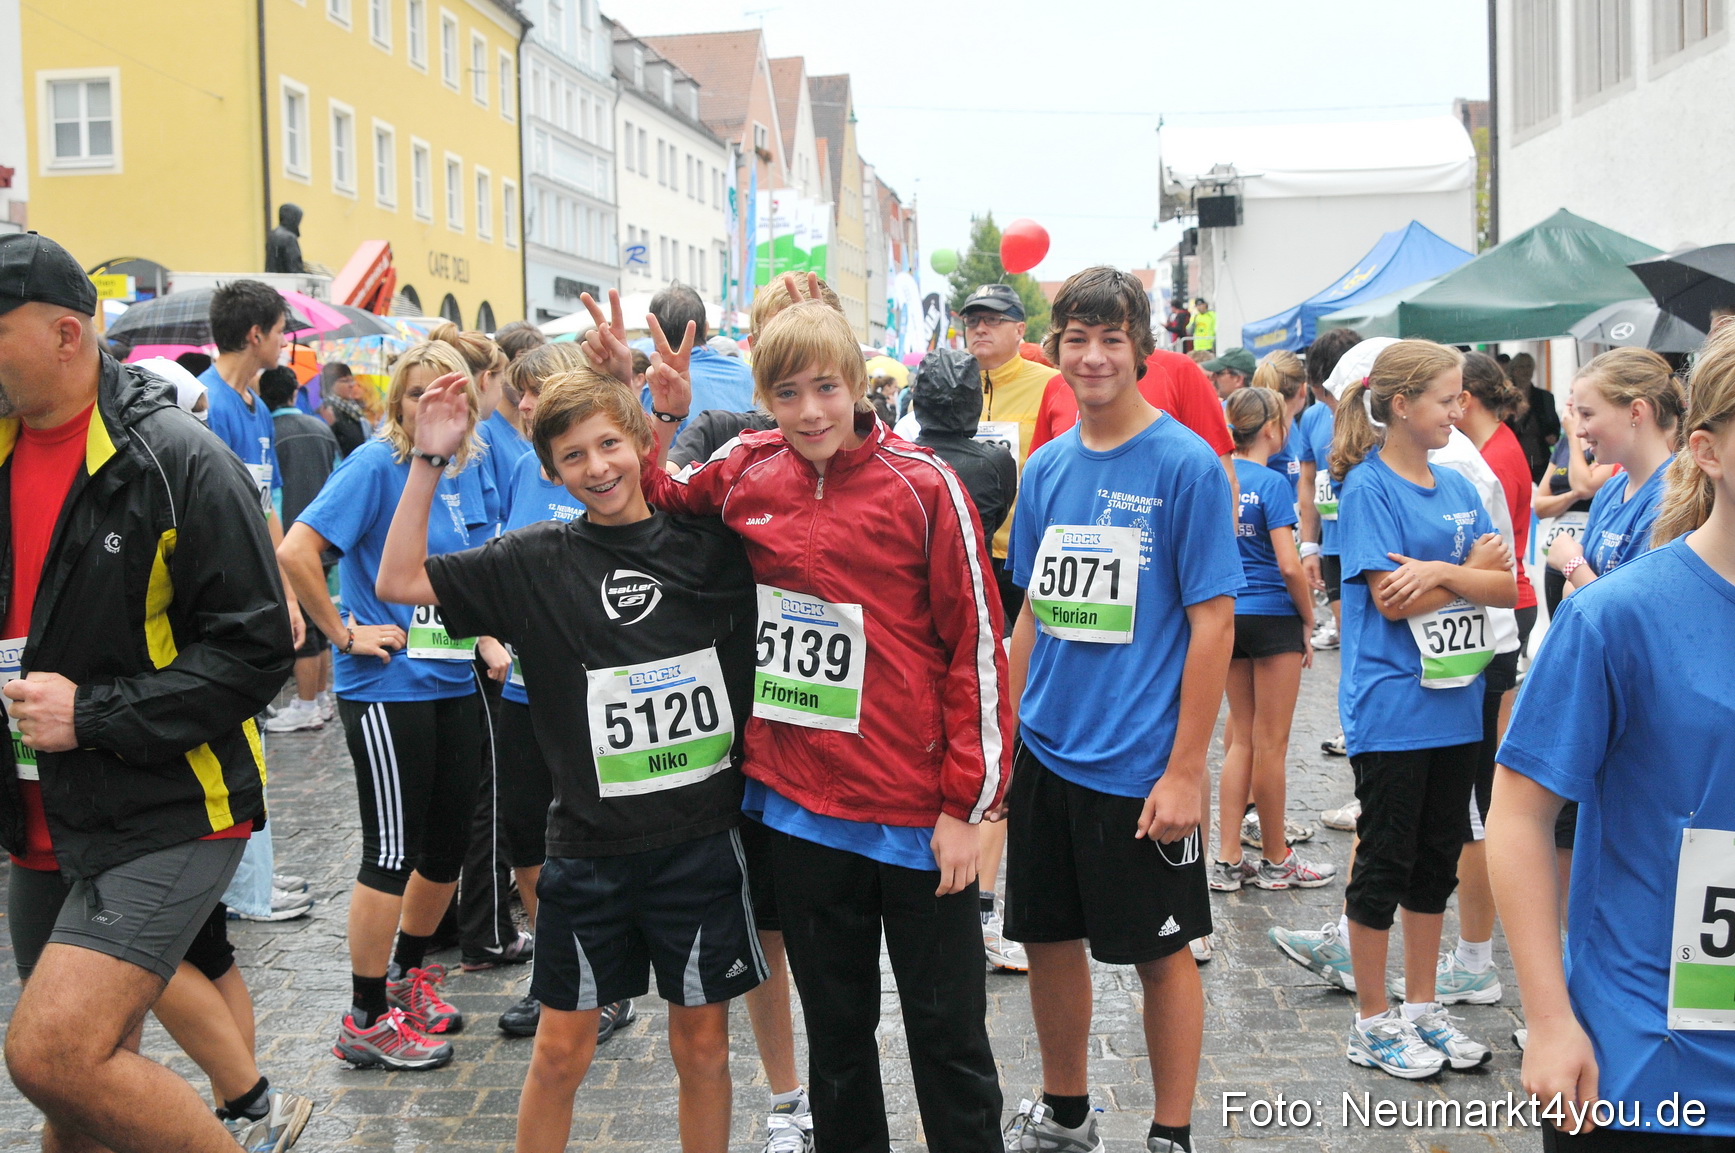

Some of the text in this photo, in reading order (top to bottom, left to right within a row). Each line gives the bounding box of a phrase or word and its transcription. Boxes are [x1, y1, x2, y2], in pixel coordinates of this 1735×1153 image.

[428, 250, 470, 284] CAFE DELI
[1097, 489, 1163, 507] 12. NEUMARKTER
[1107, 500, 1152, 514] STADTLAUF
[1238, 492, 1259, 505] ch
[746, 517, 766, 526] JAKO
[1062, 533, 1101, 545] BOCK
[1039, 556, 1121, 600] 5071
[782, 598, 825, 617] BOCK
[1052, 606, 1098, 625] Florian
[1422, 614, 1486, 654] 5227
[756, 620, 852, 682] 5139
[629, 664, 681, 686] BOCK
[761, 680, 819, 709] Florian
[605, 685, 720, 750] 5120
[648, 752, 688, 773] Niko
[1158, 924, 1180, 937] adidas
[726, 965, 748, 978] adidas
